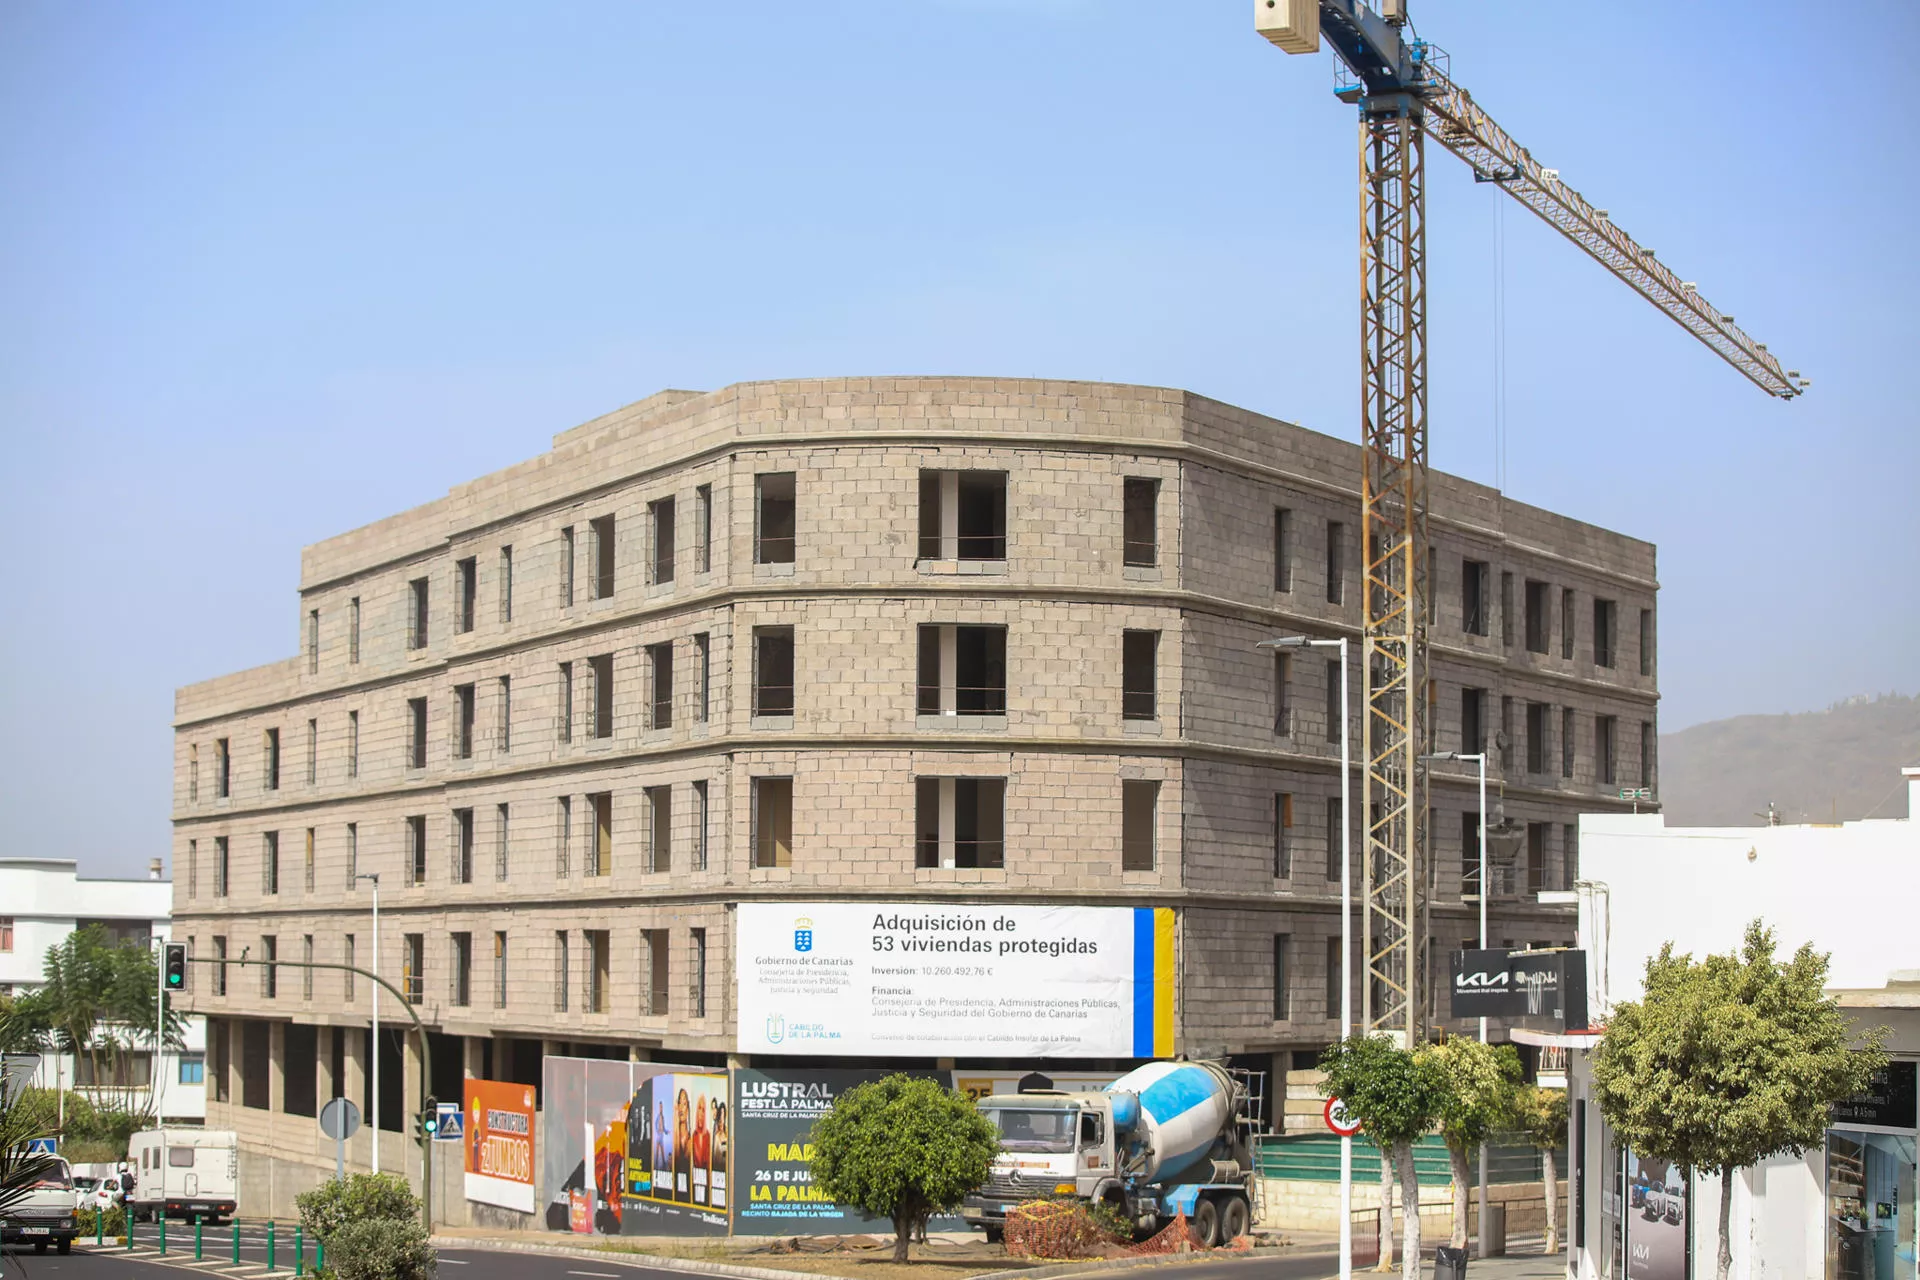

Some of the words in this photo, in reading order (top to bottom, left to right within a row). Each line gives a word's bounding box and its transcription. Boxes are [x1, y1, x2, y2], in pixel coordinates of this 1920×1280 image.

[872, 914, 986, 934] Adquisición
[993, 915, 1016, 931] de
[872, 936, 894, 952] 53
[901, 935, 992, 952] viviendas
[999, 937, 1098, 957] protegidas
[755, 956, 798, 965] Gobierno
[799, 956, 810, 965] de
[811, 956, 854, 966] Canarias
[921, 966, 985, 977] 10.260.492,76
[986, 967, 993, 976] €
[1456, 971, 1509, 987] KIA
[925, 997, 936, 1006] de
[939, 997, 997, 1008] Presidencia,
[999, 998, 1079, 1008] Administraciones
[1081, 998, 1120, 1010] Públicas,
[871, 1008, 908, 1017] Justicia
[910, 1009, 917, 1018] y
[919, 1007, 968, 1019] Seguridad
[970, 1008, 985, 1017] del
[988, 1008, 1032, 1018] Gobierno
[1034, 1009, 1046, 1018] de
[1048, 1009, 1088, 1018] Canarias
[788, 1031, 798, 1039] DE
[801, 1031, 811, 1039] LA
[741, 1081, 834, 1098] LUSTRAL
[791, 1099, 834, 1109] PALMA
[755, 1170, 772, 1181] 26
[773, 1170, 790, 1181] DE
[750, 1185, 772, 1201] LA
[777, 1185, 837, 1202] PALMA
